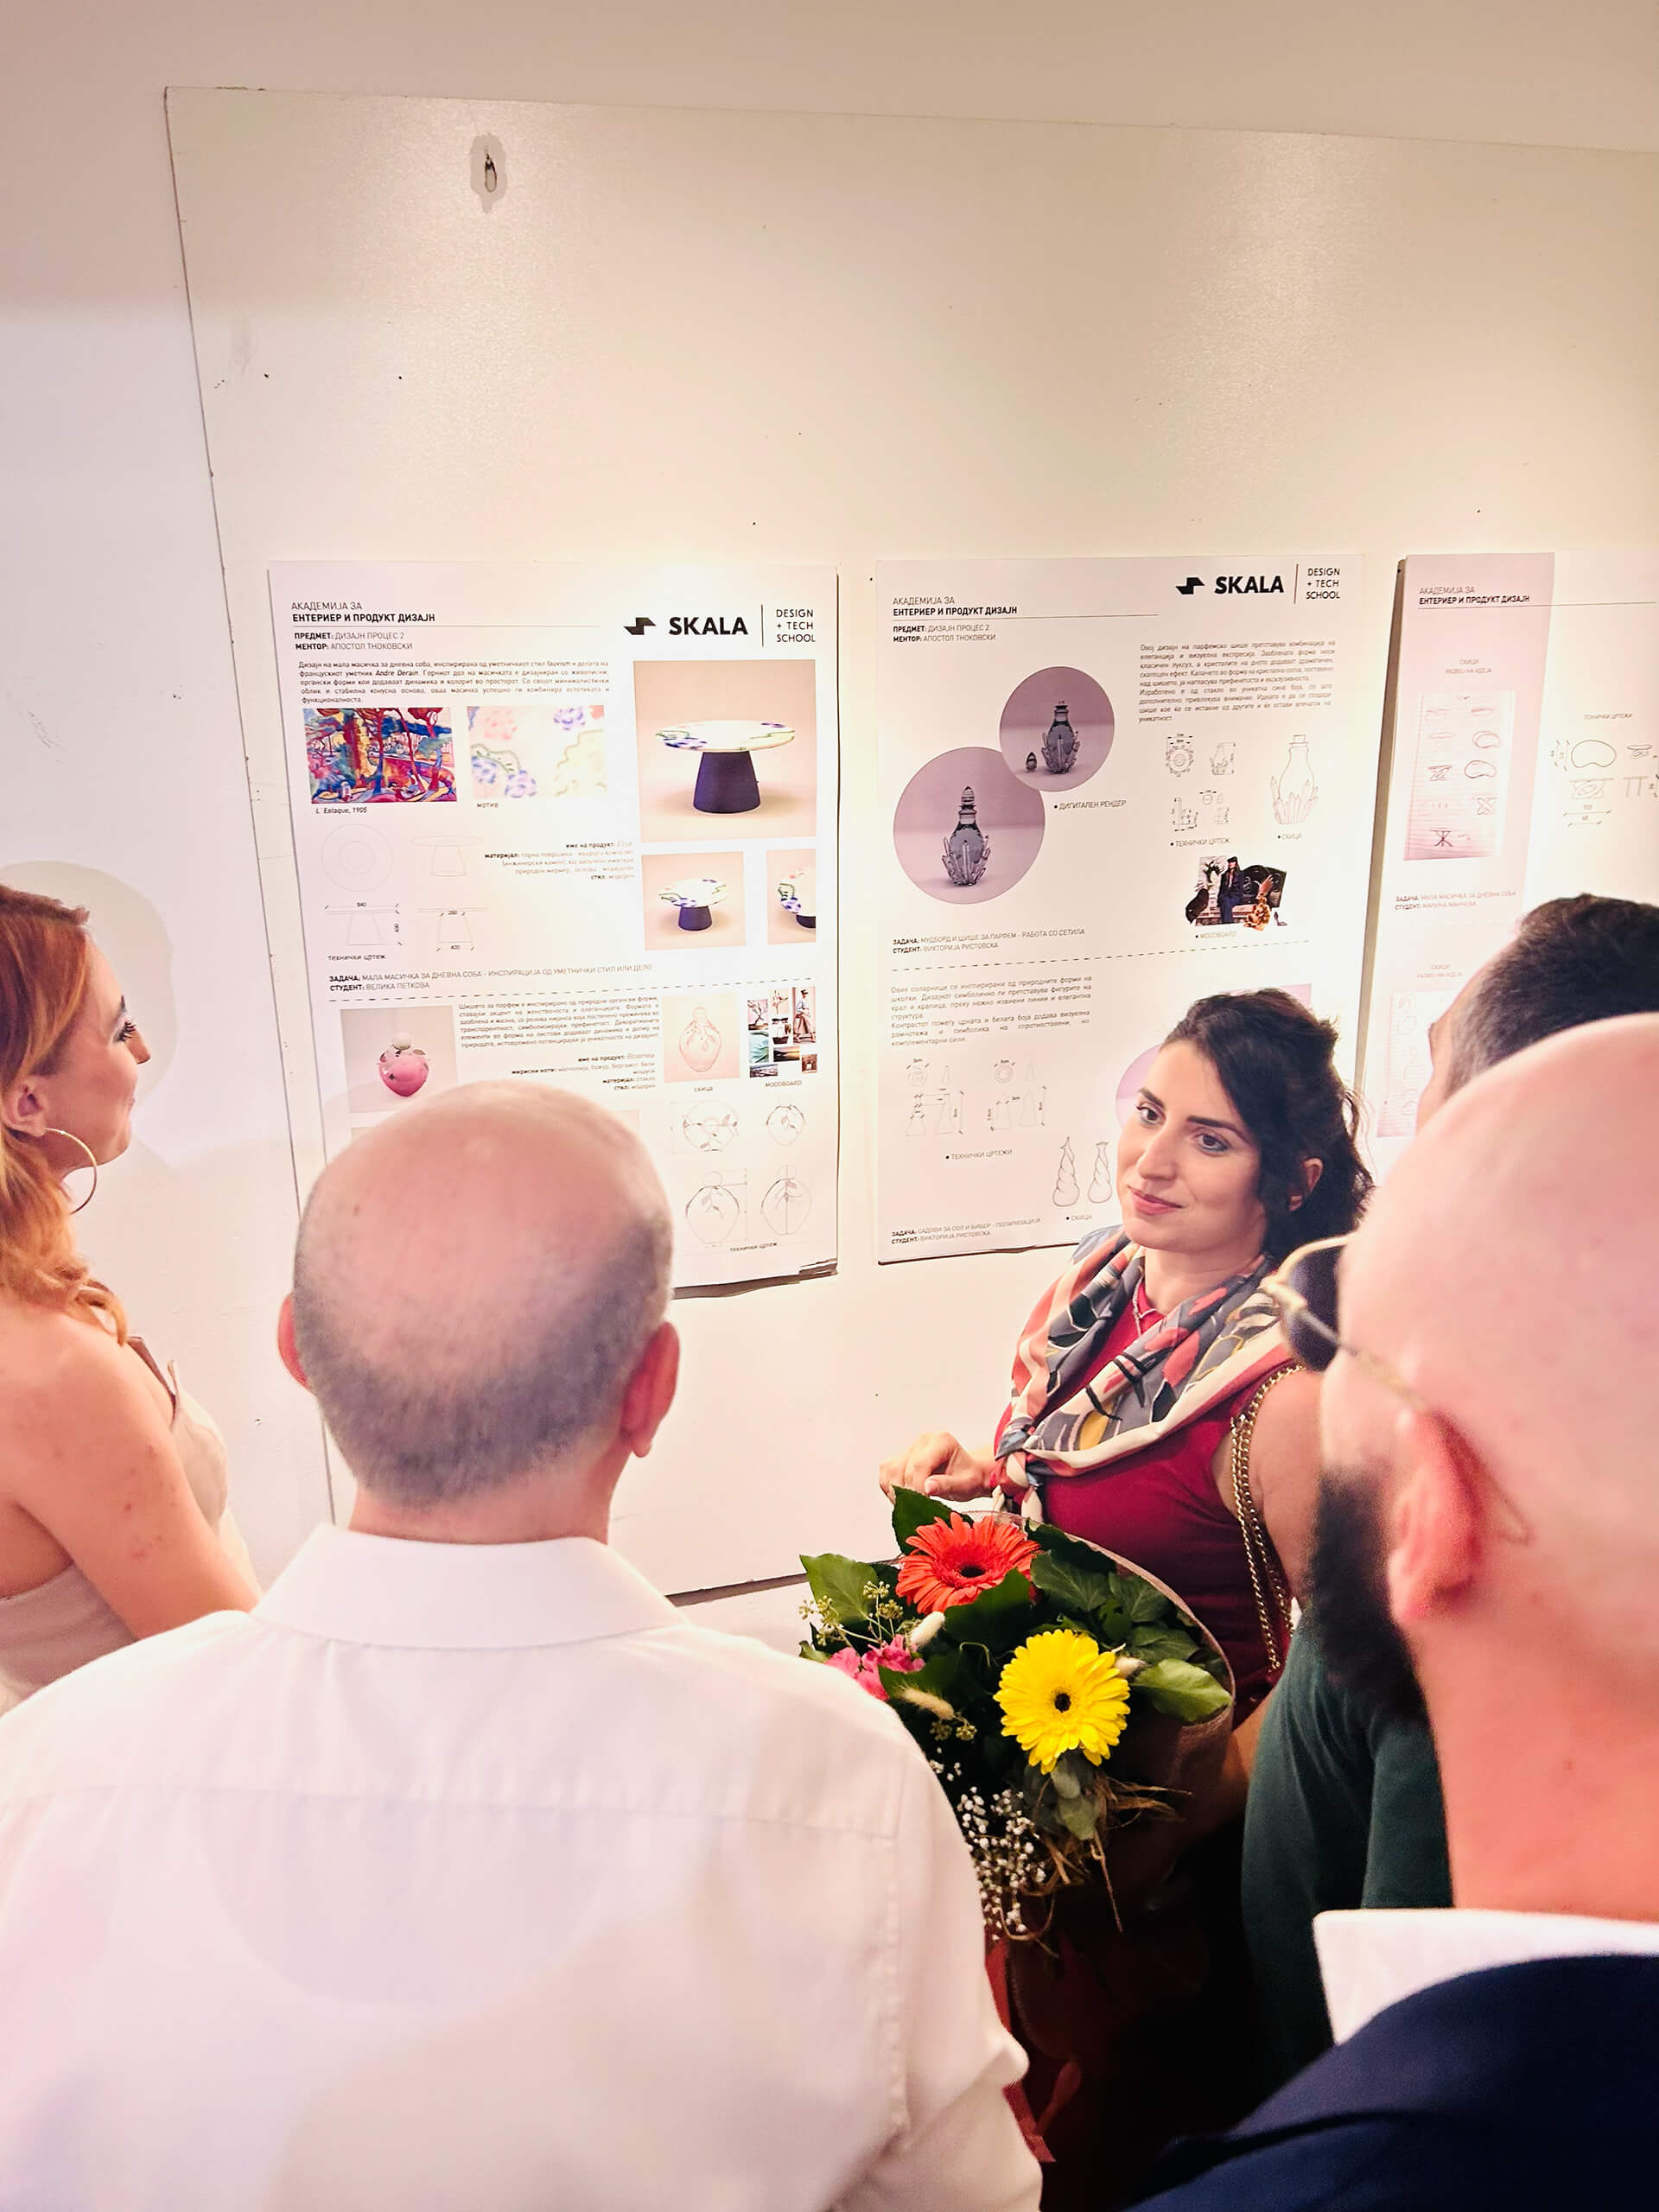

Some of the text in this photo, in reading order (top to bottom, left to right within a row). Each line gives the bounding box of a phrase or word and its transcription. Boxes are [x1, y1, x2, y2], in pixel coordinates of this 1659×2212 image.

[1308, 568, 1340, 576] DESIGN
[1215, 575, 1284, 594] SKALA
[1316, 580, 1339, 588] TECH
[1306, 591, 1340, 600] SCHOOL
[893, 596, 956, 606] АКАДЕМИЈА ЗА
[291, 602, 363, 611] АКАДЕМИЈА ЗА
[776, 609, 814, 618] DESIGN
[946, 607, 983, 616] ПРОДУКТ
[985, 607, 1018, 615] ДИЗАЈН
[397, 613, 435, 623] ДИЗАЈН
[670, 617, 747, 635] SKALA
[927, 625, 955, 633] ДИЗАЈН
[957, 624, 984, 632] ПРОЦЕС
[367, 632, 397, 640] ПРОЦЕС
[400, 632, 404, 640] 2
[777, 634, 815, 643] SCHOOL
[1058, 801, 1099, 810] ДИГИТАЛЕН
